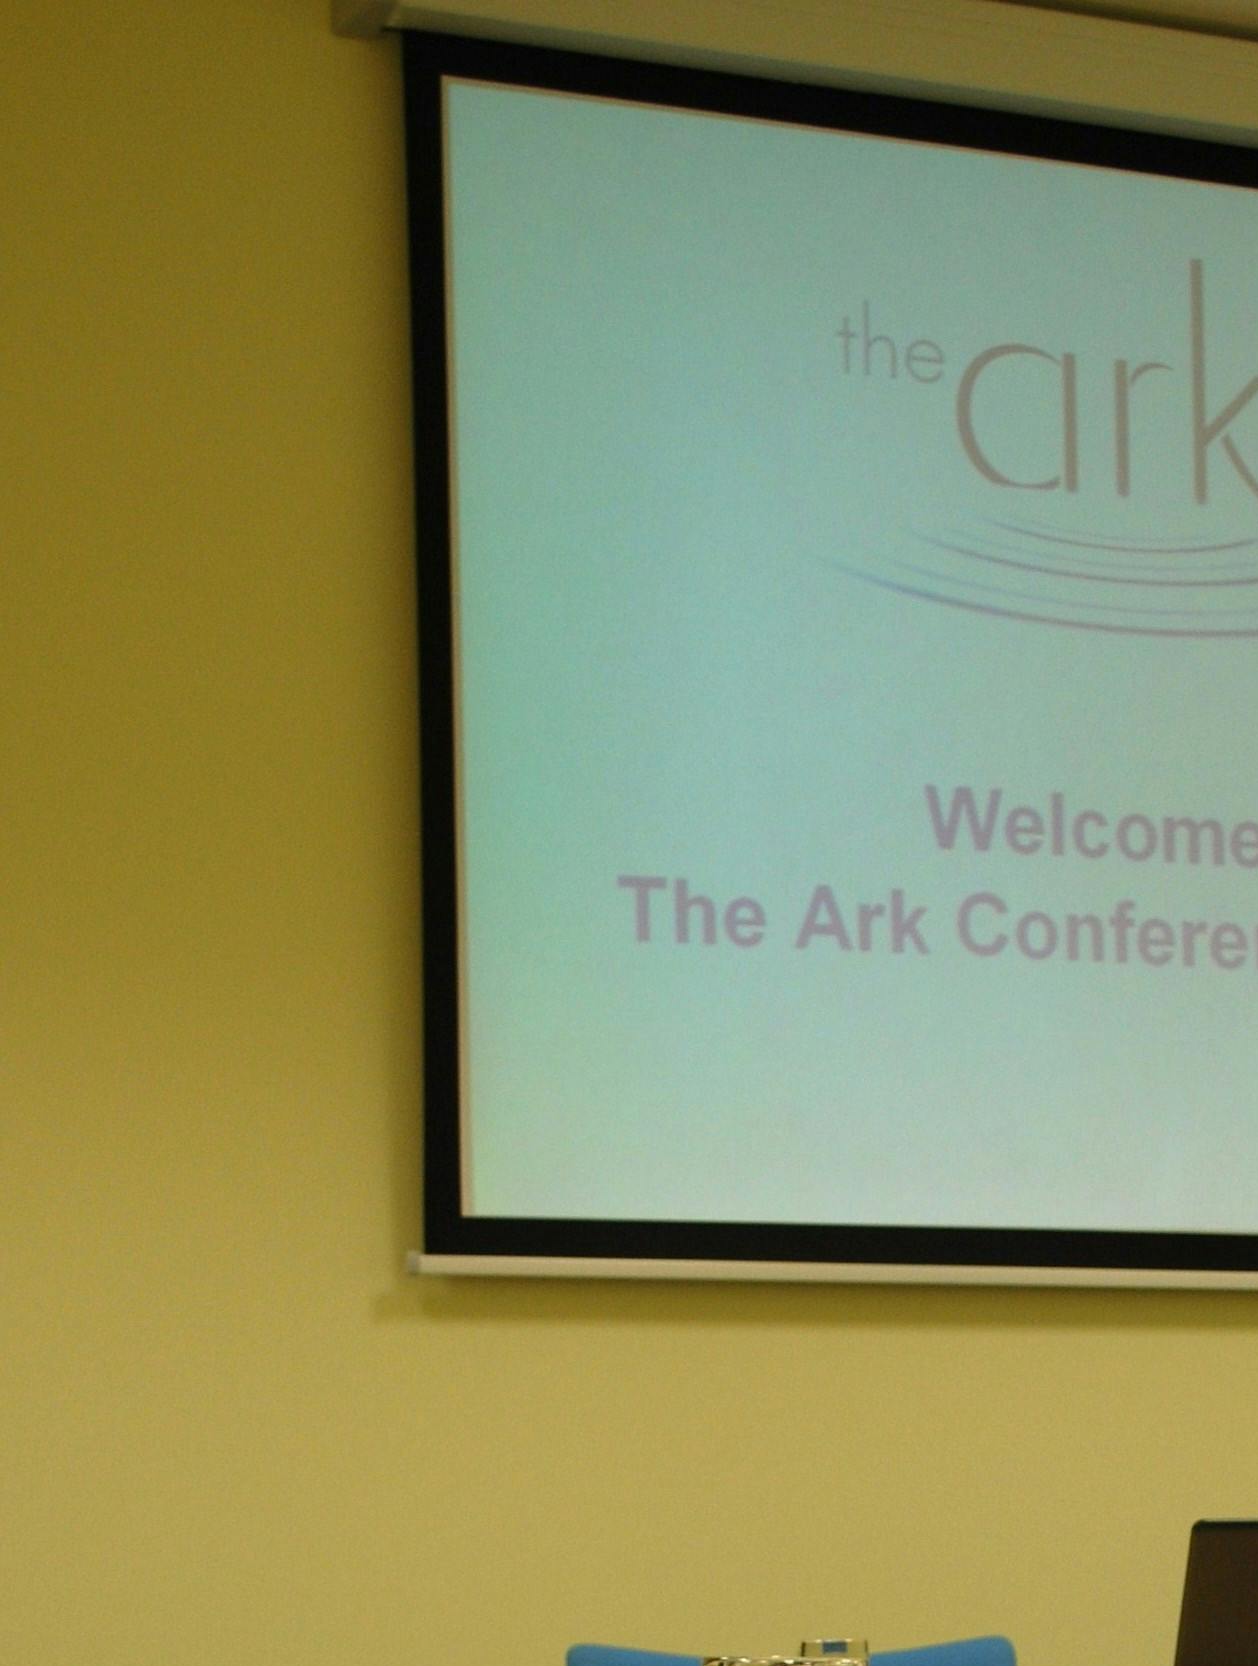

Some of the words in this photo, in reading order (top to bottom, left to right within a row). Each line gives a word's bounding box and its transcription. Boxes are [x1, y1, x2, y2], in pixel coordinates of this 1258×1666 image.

[836, 300, 946, 383] the
[617, 875, 767, 948] The
[794, 884, 931, 957] Ark
